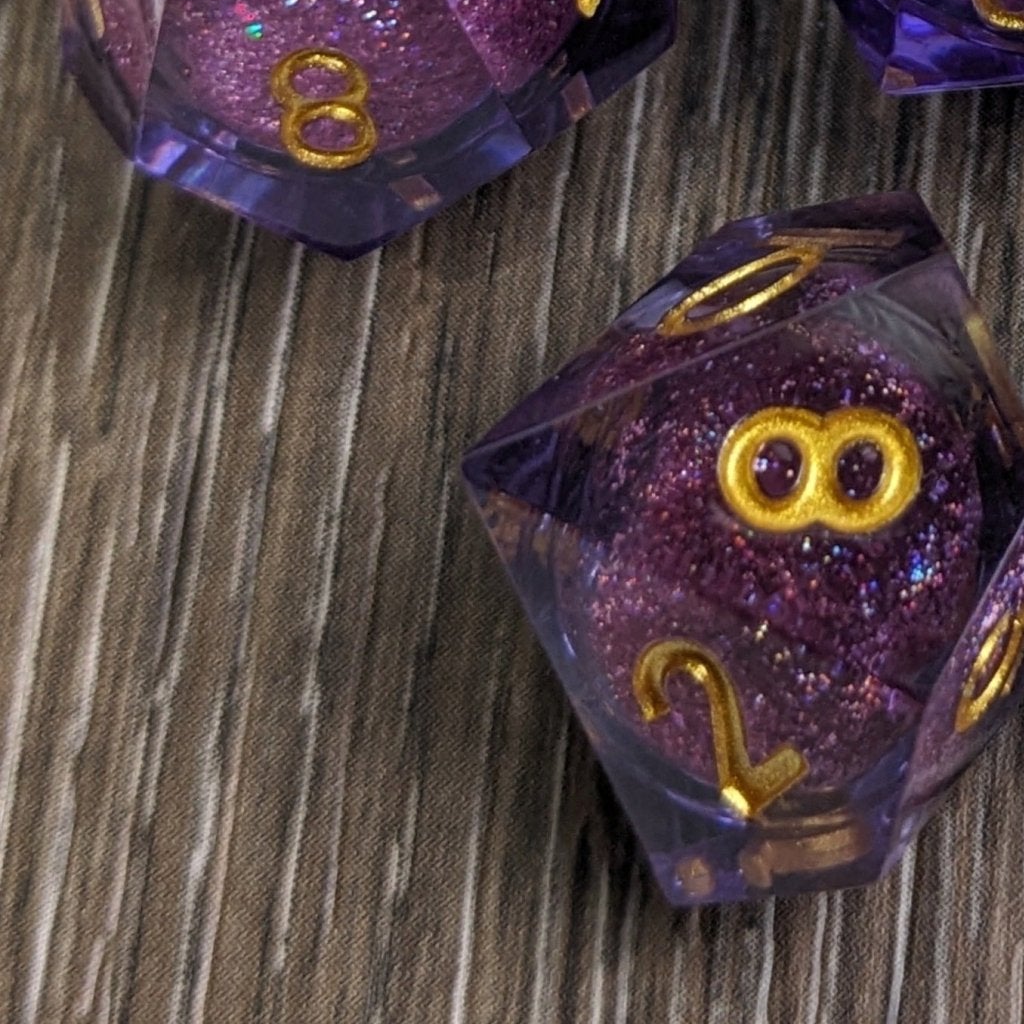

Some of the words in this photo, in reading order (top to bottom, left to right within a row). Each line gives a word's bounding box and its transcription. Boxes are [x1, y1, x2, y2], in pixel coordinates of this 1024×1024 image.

[271, 47, 379, 171] 8
[717, 404, 925, 534] 8
[631, 639, 810, 822] 2
